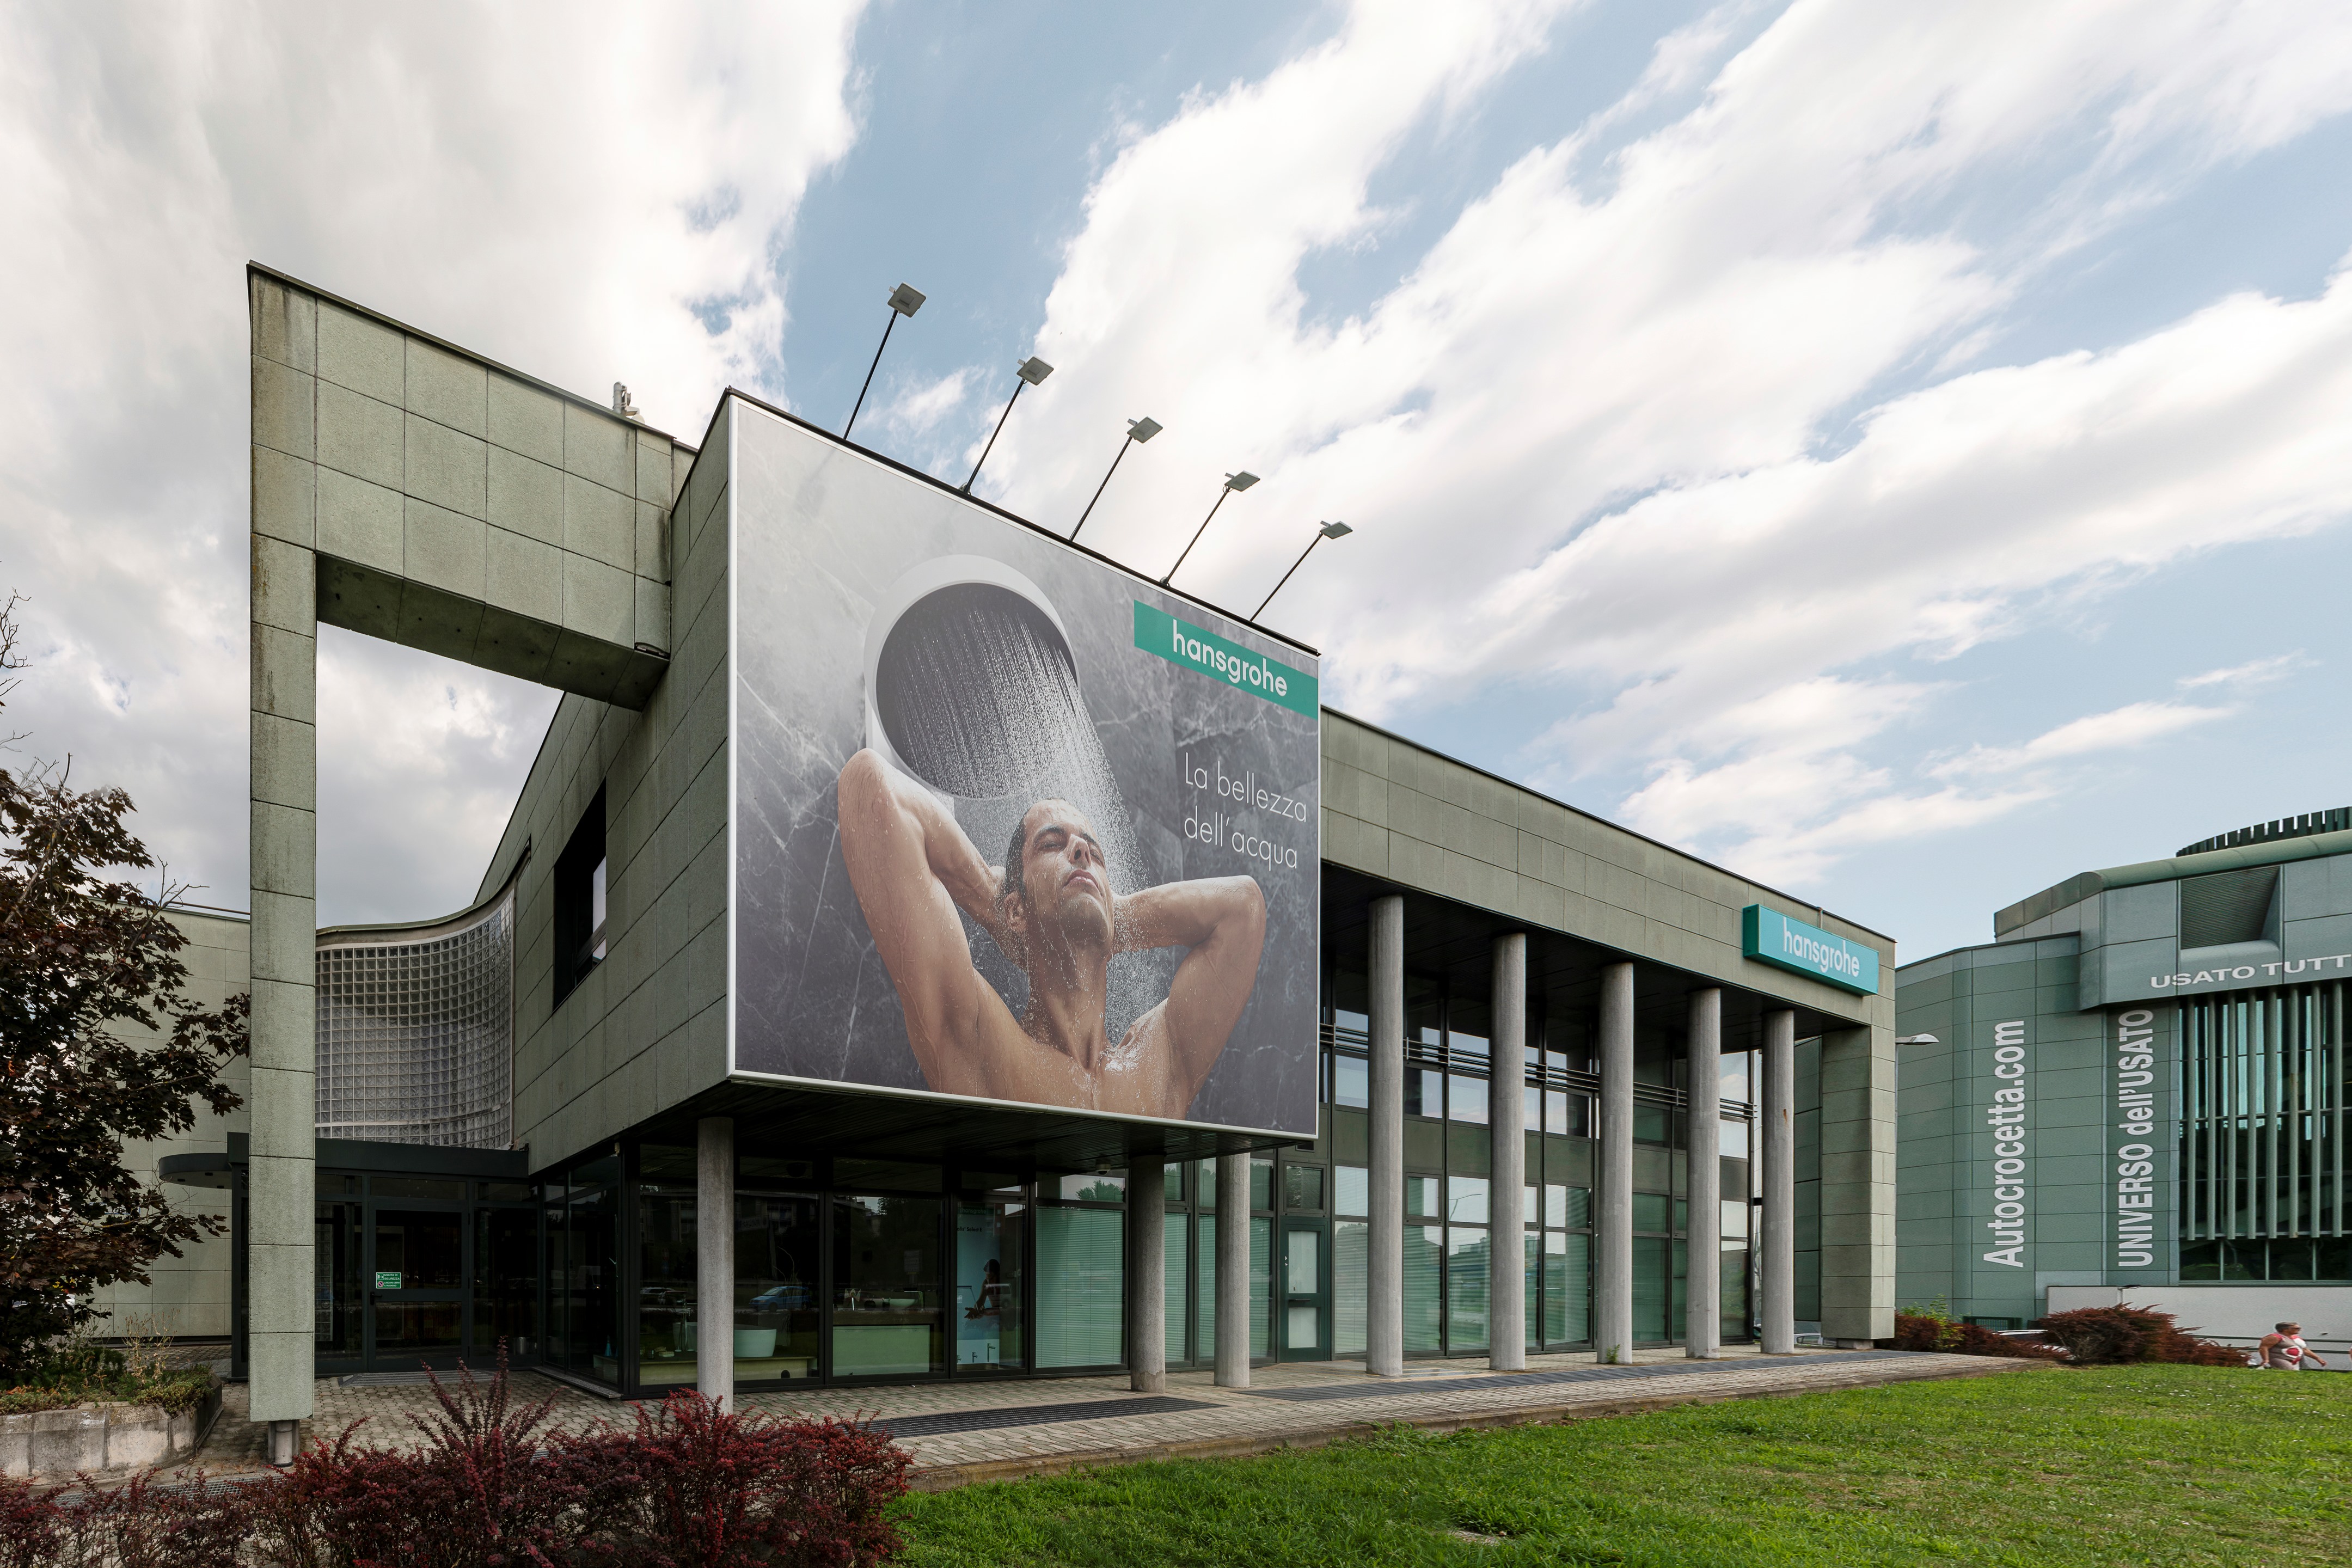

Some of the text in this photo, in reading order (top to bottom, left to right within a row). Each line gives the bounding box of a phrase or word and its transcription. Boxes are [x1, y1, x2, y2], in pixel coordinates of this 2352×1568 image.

[1173, 619, 1287, 696] hansgrohe
[1186, 752, 1306, 822] La bellezza
[1184, 805, 1297, 871] dell'acqua
[1783, 916, 1860, 977] hansgrohe
[2151, 954, 2352, 988] USATO TUTT
[1983, 1020, 2025, 1268] Autocrocetta.com
[2118, 1009, 2154, 1267] UNIVERSO dell'USATO
